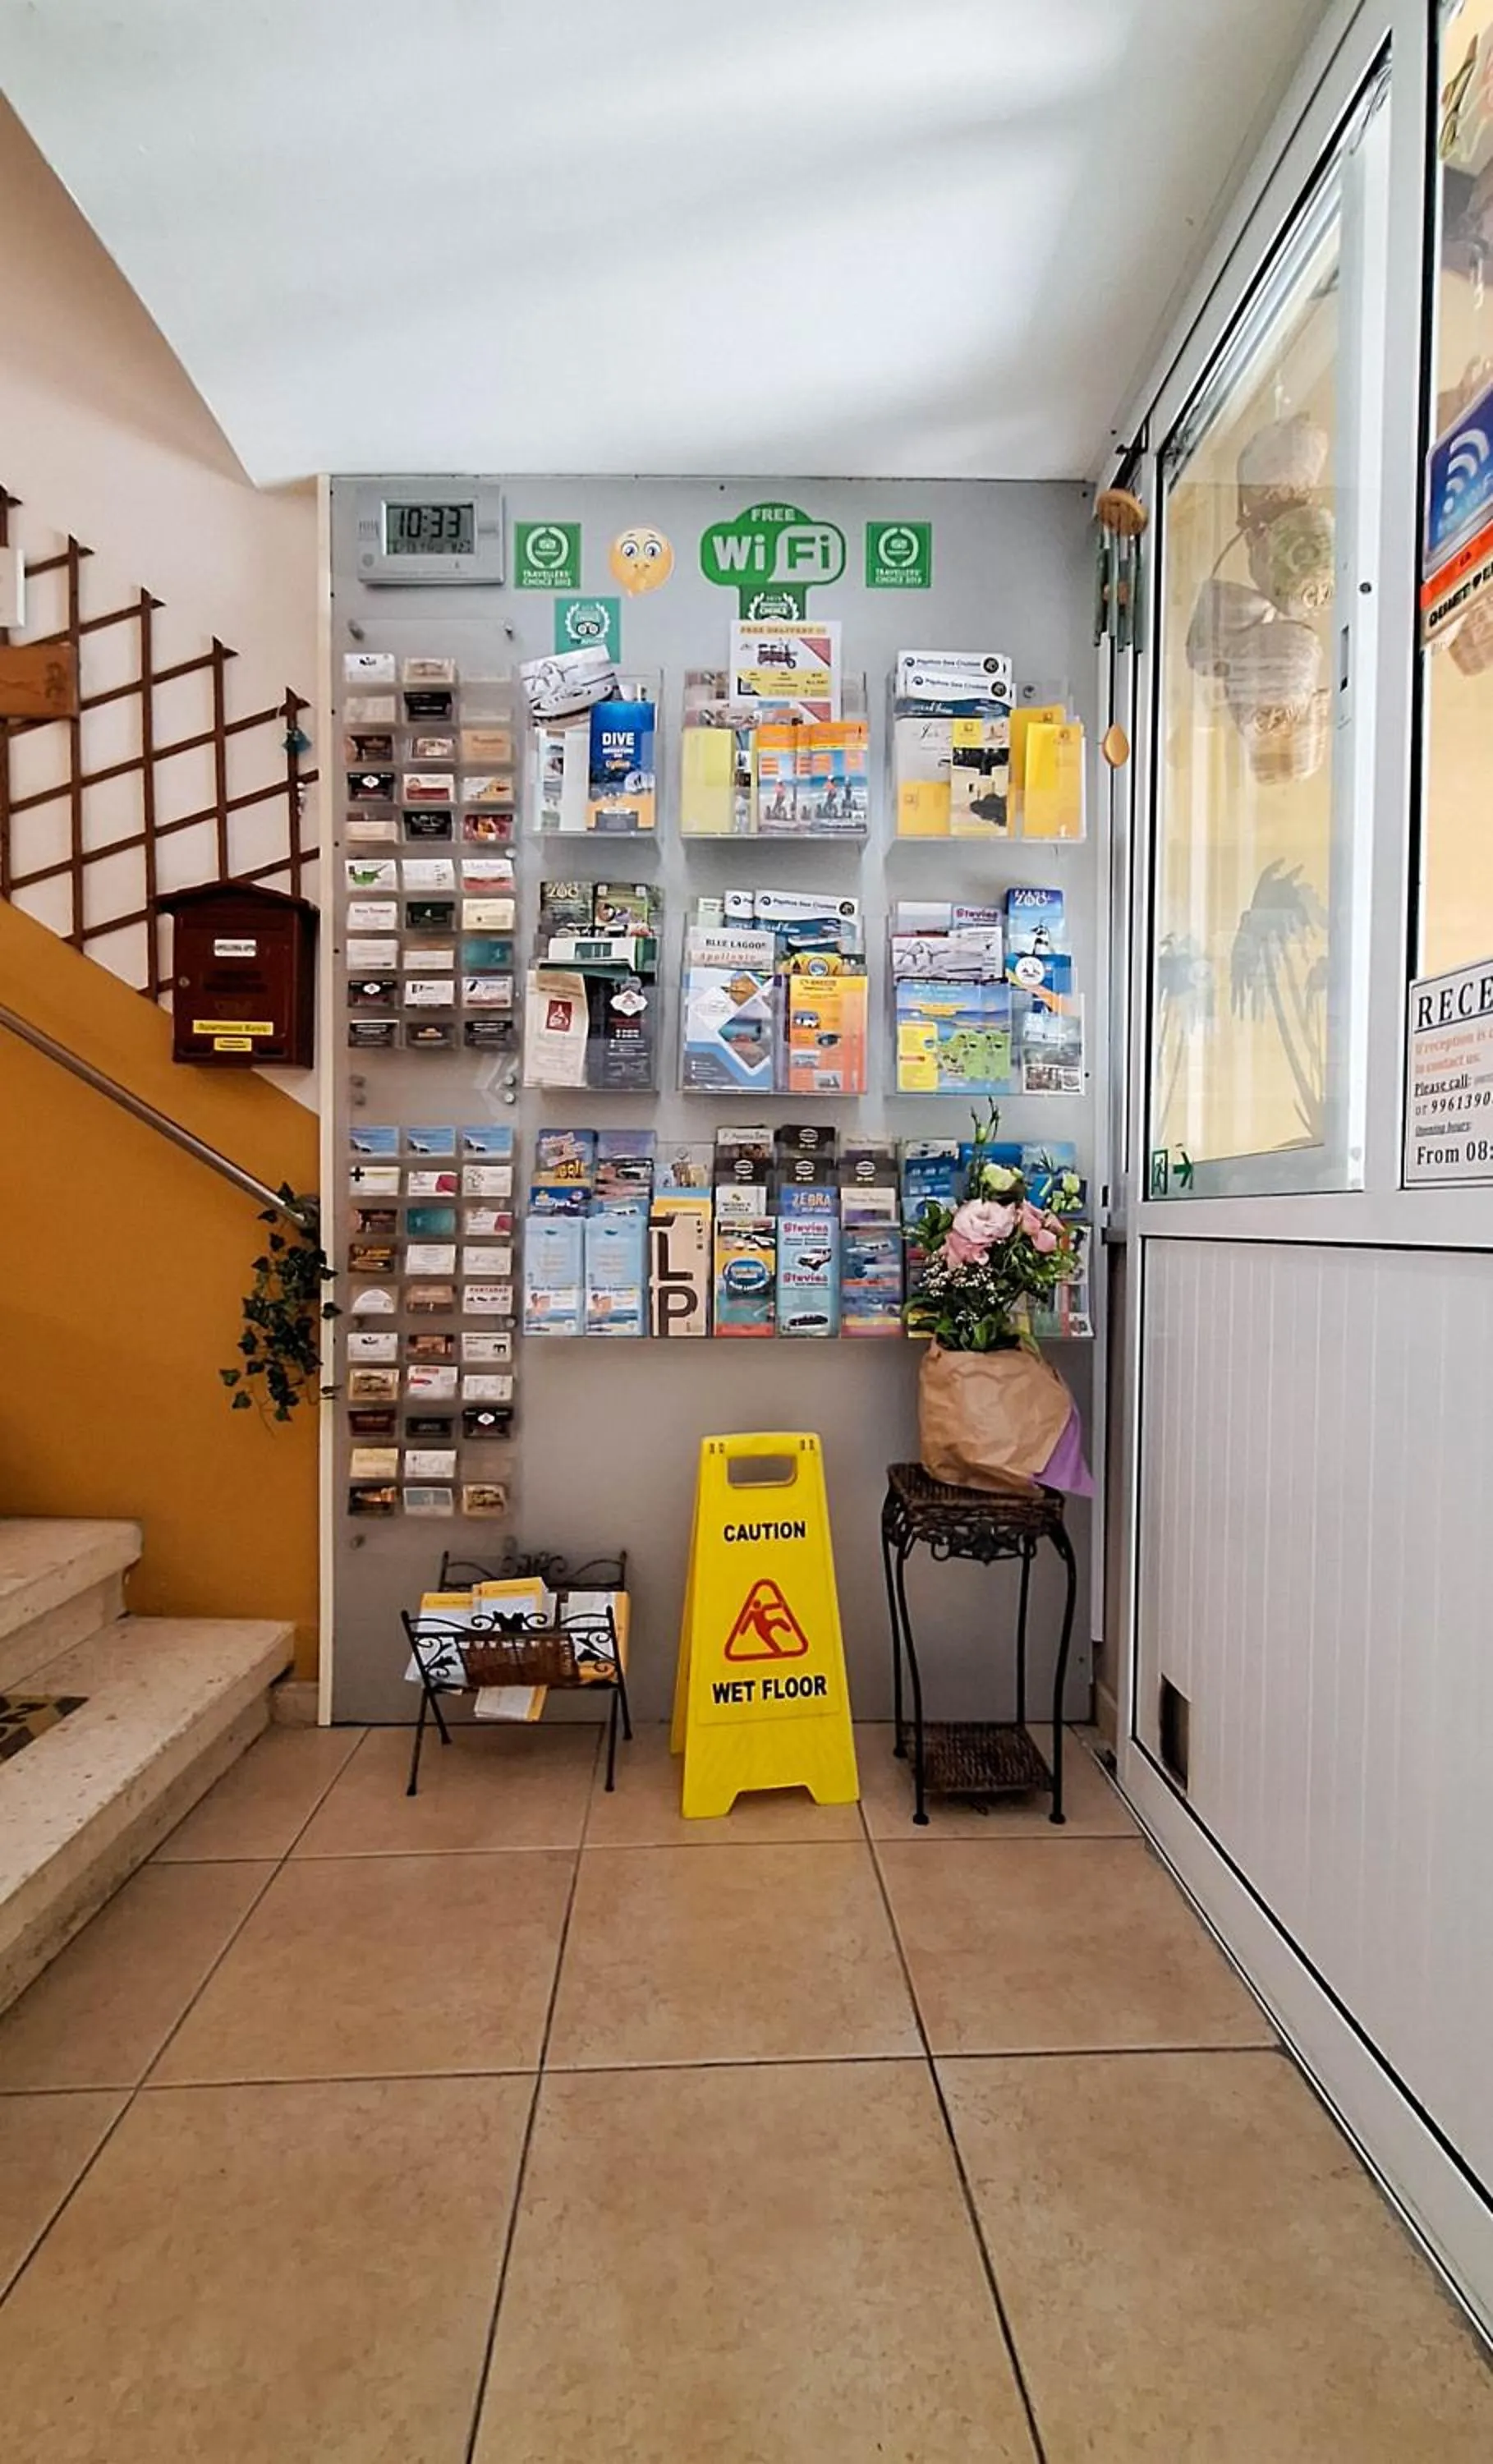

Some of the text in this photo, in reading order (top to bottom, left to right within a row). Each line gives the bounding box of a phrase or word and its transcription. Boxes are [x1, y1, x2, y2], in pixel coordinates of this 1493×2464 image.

[400, 507, 461, 538] 10:33
[751, 508, 796, 522] FREE
[1472, 561, 1493, 590] PE
[602, 732, 635, 746] DIVE
[705, 938, 727, 947] BLUE
[1430, 1032, 1474, 1052] reception
[1414, 1080, 1447, 1097] Please
[1449, 1073, 1472, 1091] call:
[1415, 1091, 1493, 1115] or 9961390
[1417, 1146, 1459, 1165] From
[724, 1521, 806, 1542] CAUTION
[712, 1676, 827, 1704] WET FLOOR
